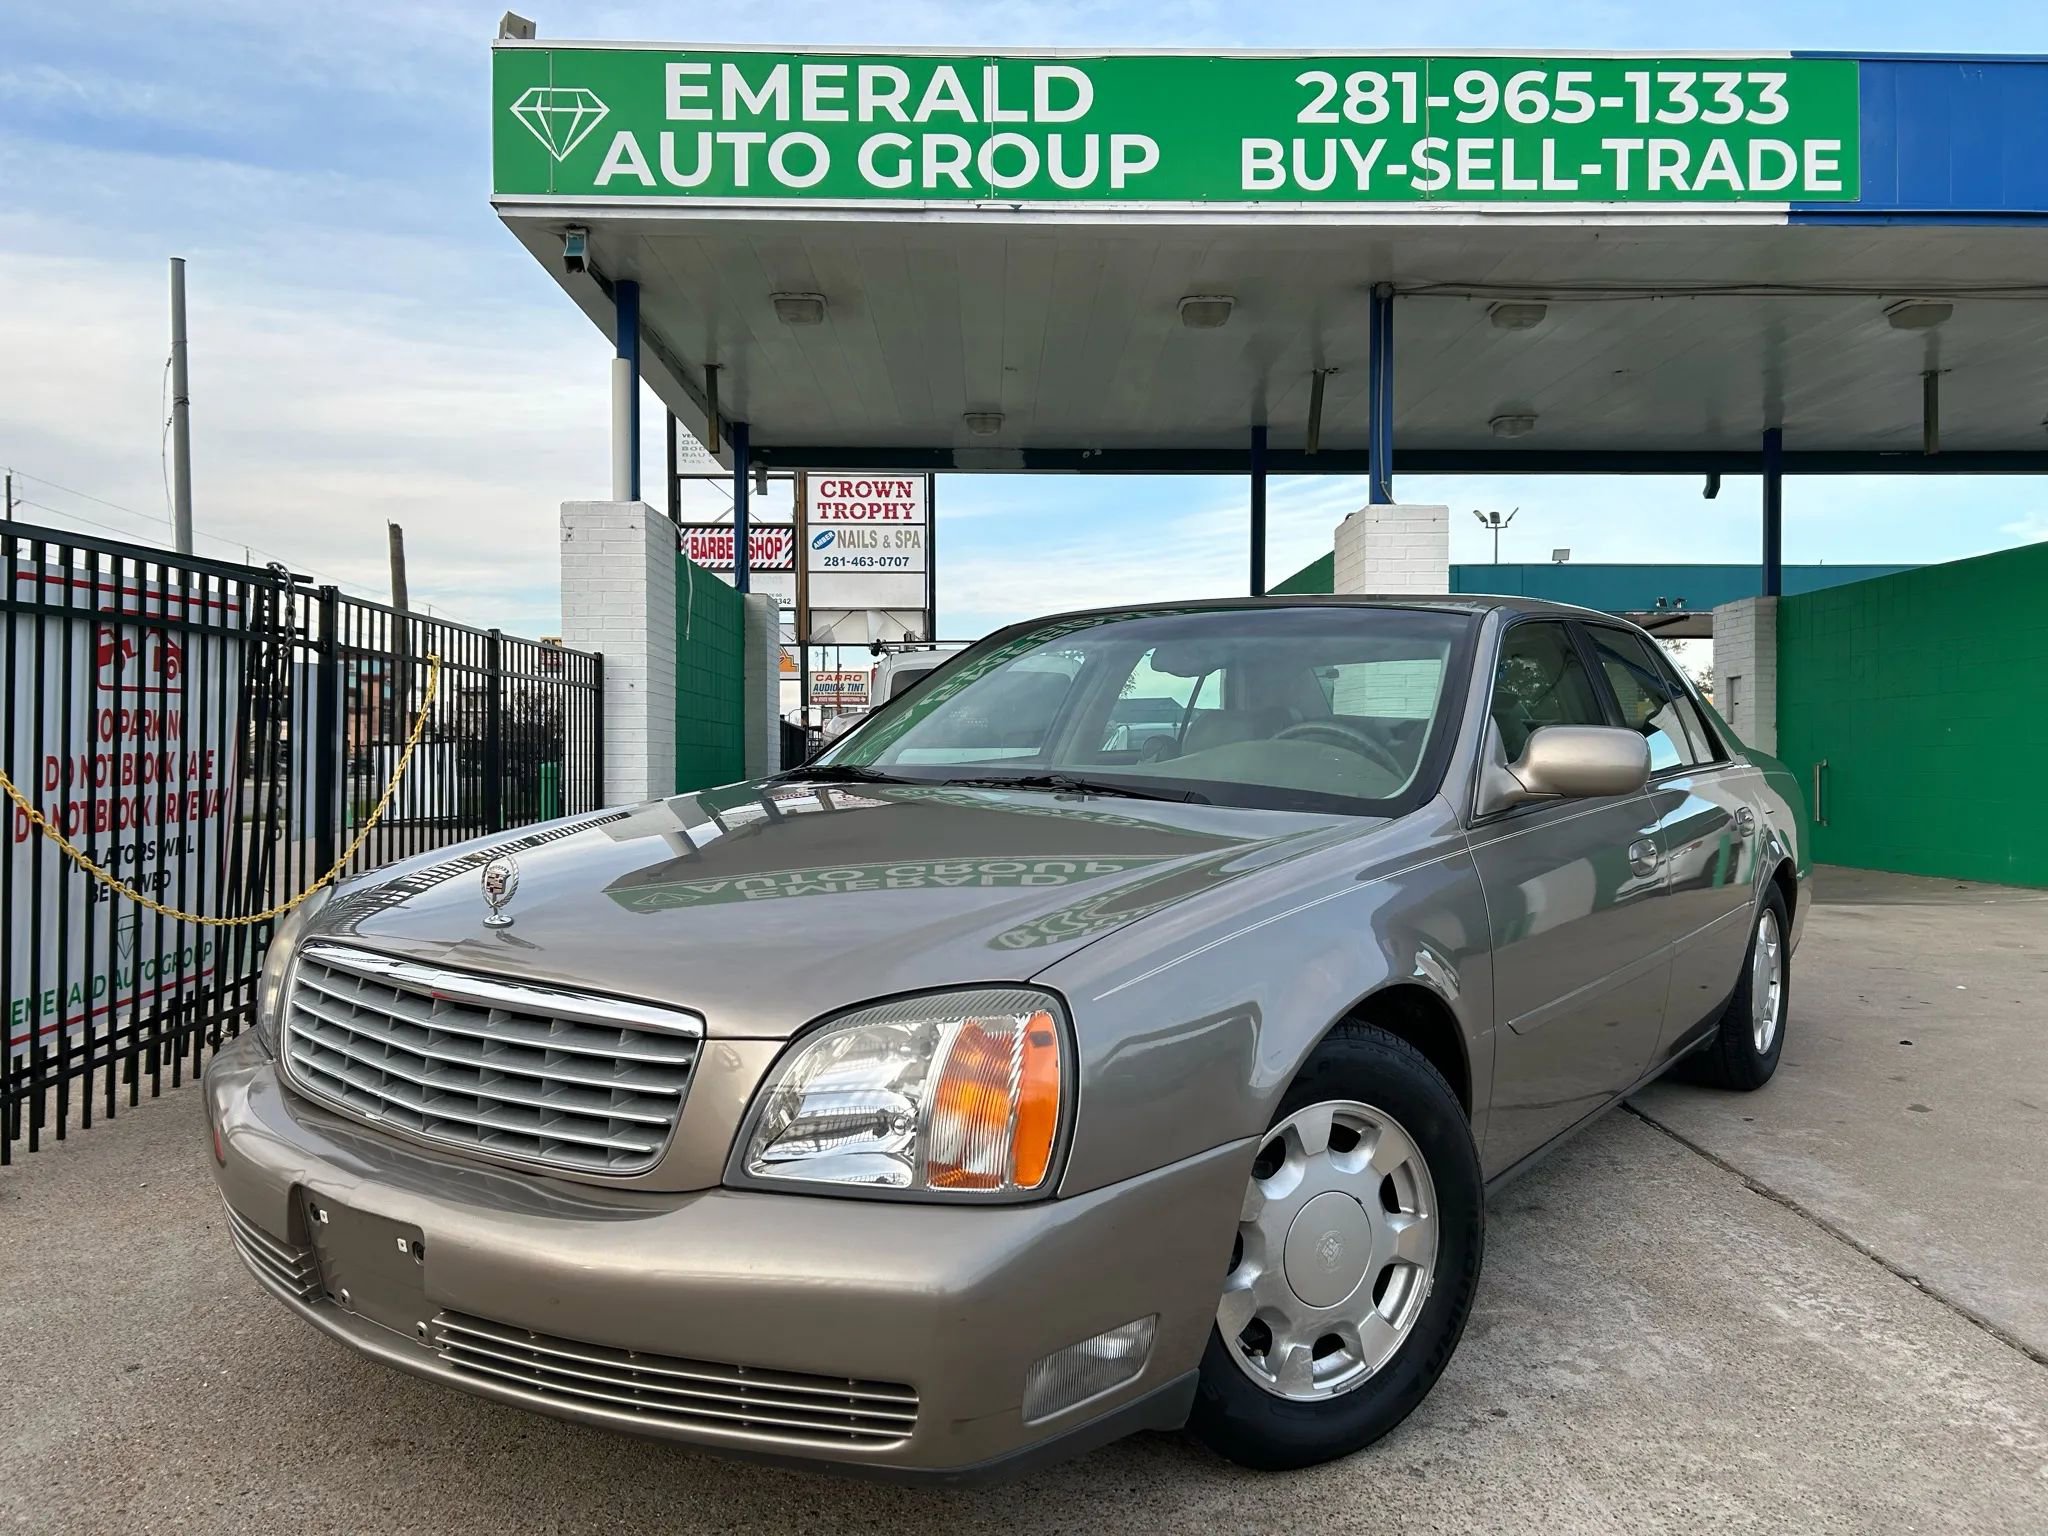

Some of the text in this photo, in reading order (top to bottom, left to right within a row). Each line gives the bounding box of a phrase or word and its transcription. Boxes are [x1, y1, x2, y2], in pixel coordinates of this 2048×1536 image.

[665, 62, 1094, 123] EMERALD
[1294, 70, 1790, 125] 281-965-1333
[592, 131, 1160, 190] AUTO GROUP
[1241, 137, 1842, 192] BUY-SELL-TRADE
[820, 480, 913, 498] CROWN
[817, 502, 915, 520] TROPHY
[690, 536, 783, 560] BARBE SHOP
[813, 529, 921, 549] AMBER NAILS & SPA
[823, 556, 910, 567] 281-463-0707
[813, 683, 838, 691] AUDIO
[847, 683, 865, 691] TINT
[815, 674, 862, 682] CARRO
[91, 708, 185, 743] O PARKN
[180, 750, 214, 781] AE
[15, 806, 44, 843] D
[155, 787, 229, 826] RIVEA
[163, 835, 194, 858] WIL
[11, 974, 106, 1027] EEAD
[161, 941, 213, 976] GOP
